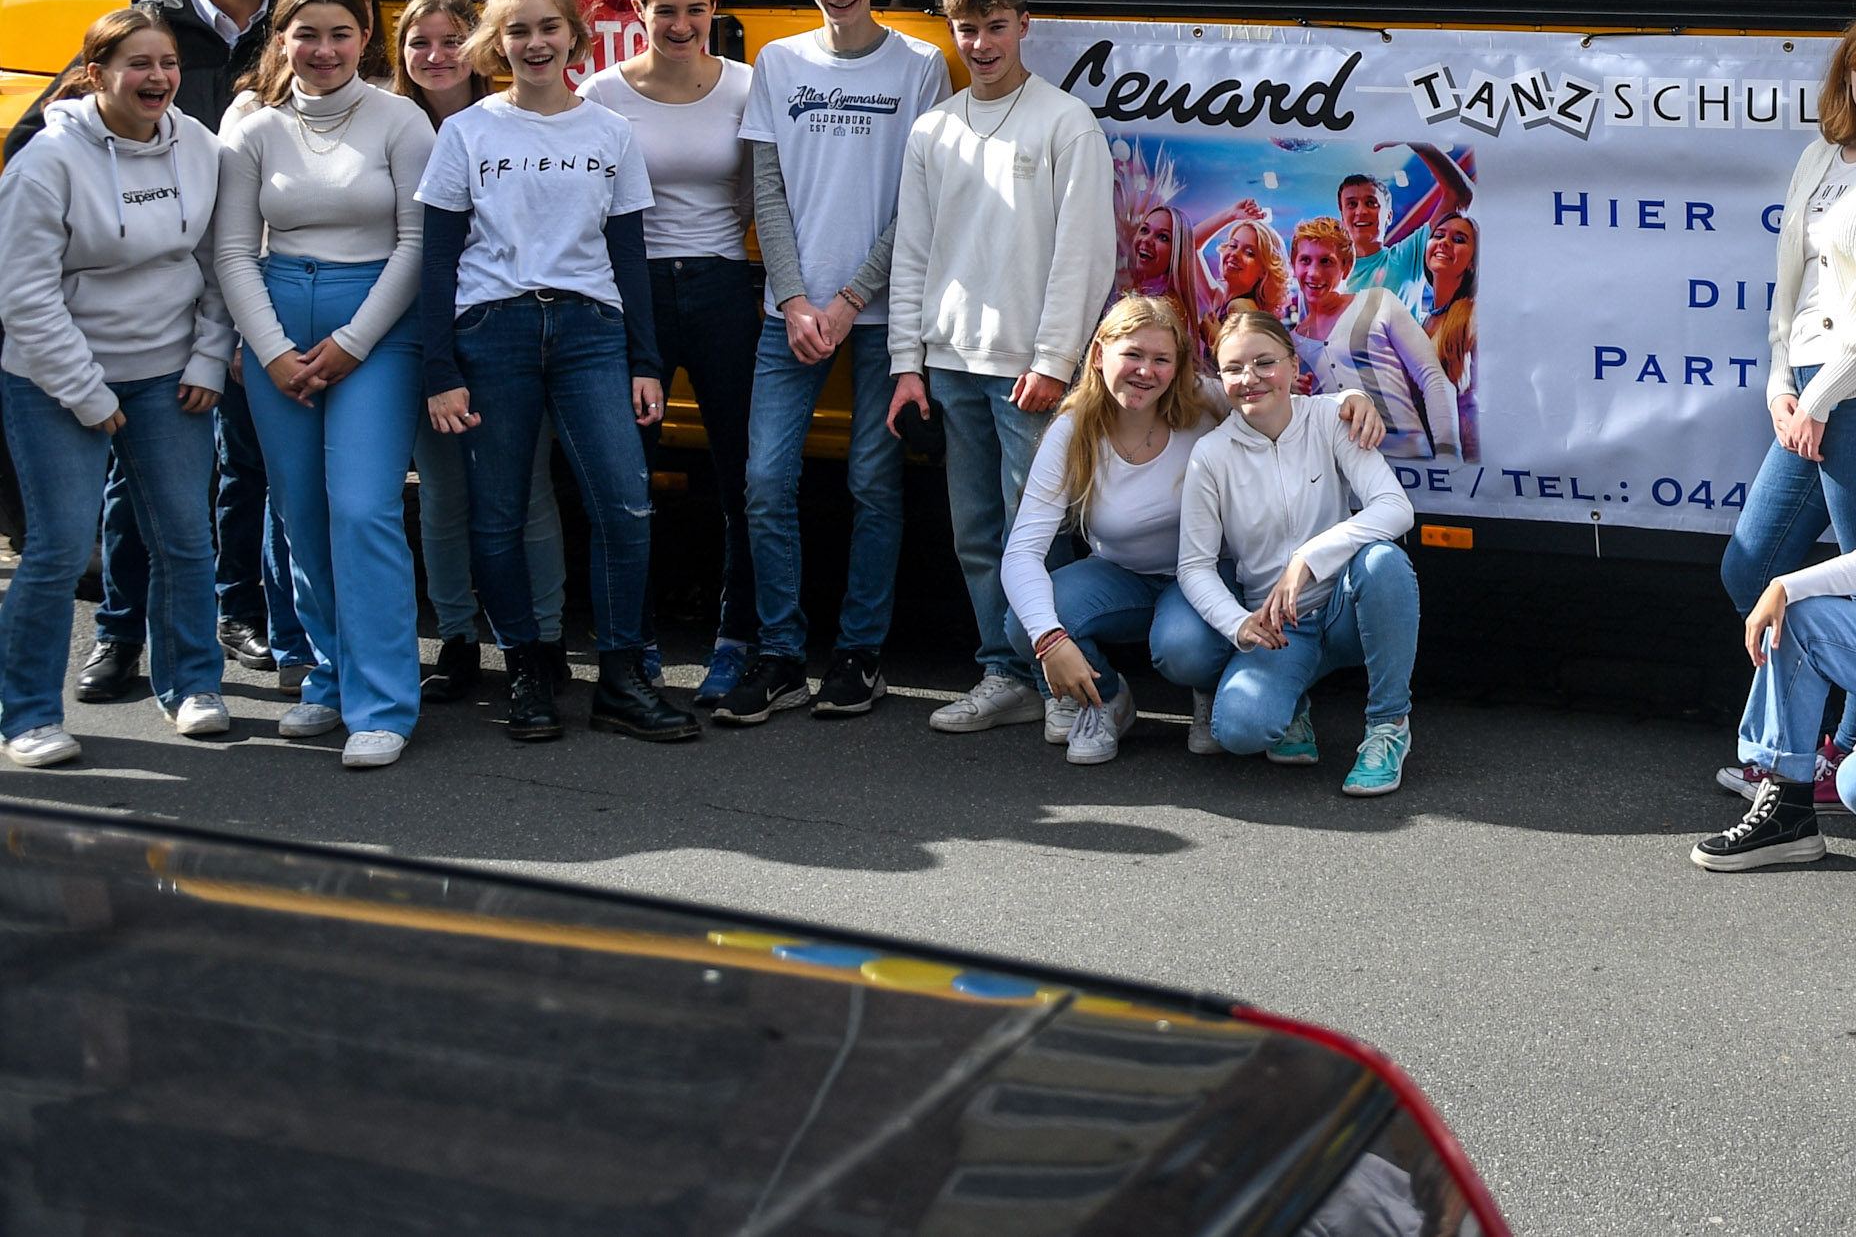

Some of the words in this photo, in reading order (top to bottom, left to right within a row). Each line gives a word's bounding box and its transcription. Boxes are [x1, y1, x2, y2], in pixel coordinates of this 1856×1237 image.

[788, 85, 827, 108] Altes
[828, 87, 901, 109] Gymnasium
[810, 113, 872, 125] OLDENBURG
[810, 125, 826, 133] EST
[851, 126, 871, 135] 1573
[1688, 279, 1776, 311] DI
[1593, 346, 1772, 387] PART
